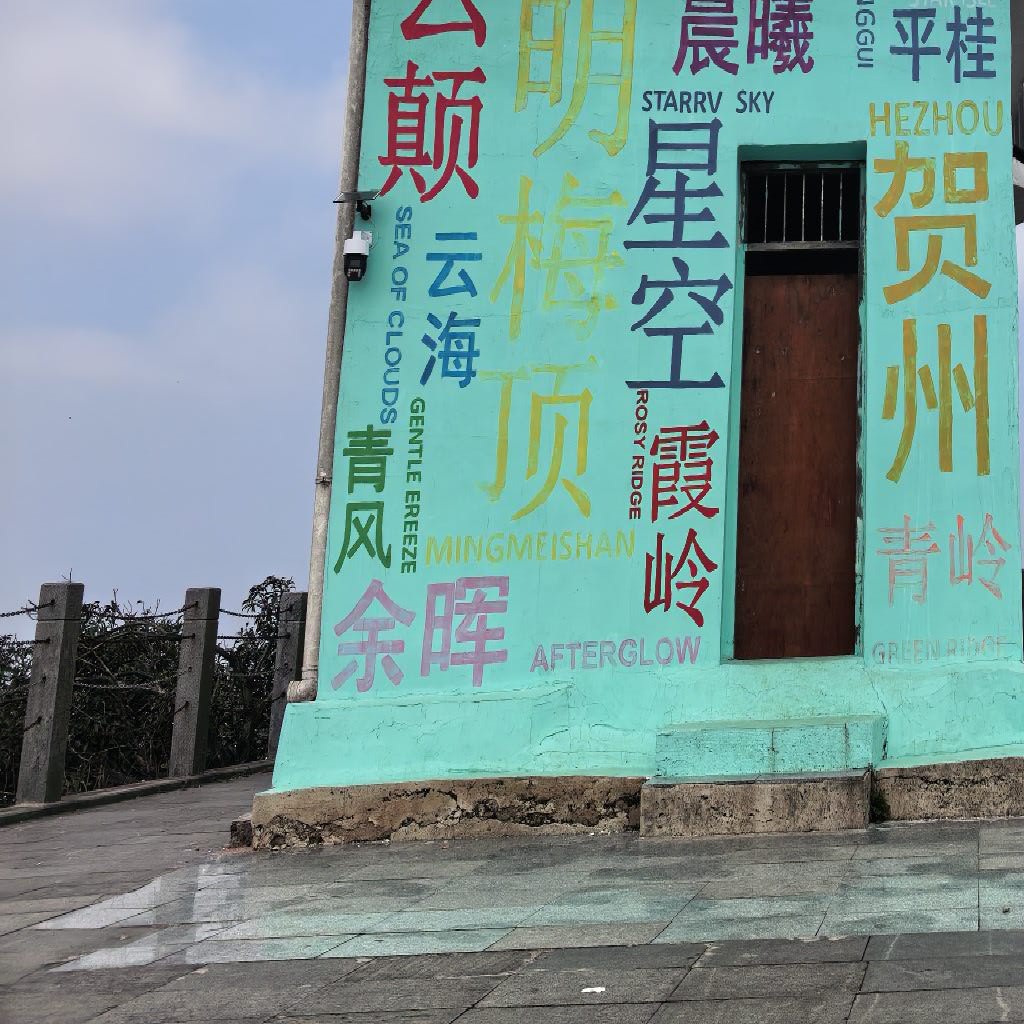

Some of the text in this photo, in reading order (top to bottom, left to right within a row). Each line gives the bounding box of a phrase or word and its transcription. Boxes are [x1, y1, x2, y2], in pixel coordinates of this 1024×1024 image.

[735, 88, 775, 114] SKY
[889, 5, 997, 84] 平桂
[869, 99, 1004, 137] HEZHOU
[419, 231, 483, 389] 云海
[623, 117, 734, 389] 星空
[872, 139, 992, 484] 贺州
[380, 206, 413, 426] SEA OF CLOUDS
[333, 423, 395, 575] 青风
[404, 396, 426, 484] GENTLE
[628, 389, 649, 521] ROSY RIDGE
[425, 528, 636, 568] MINGMEISHAN
[643, 419, 721, 629] 霞岭
[875, 512, 1013, 609] 青岭
[330, 576, 510, 694] 余晖
[529, 636, 703, 673] AFTERGLOW
